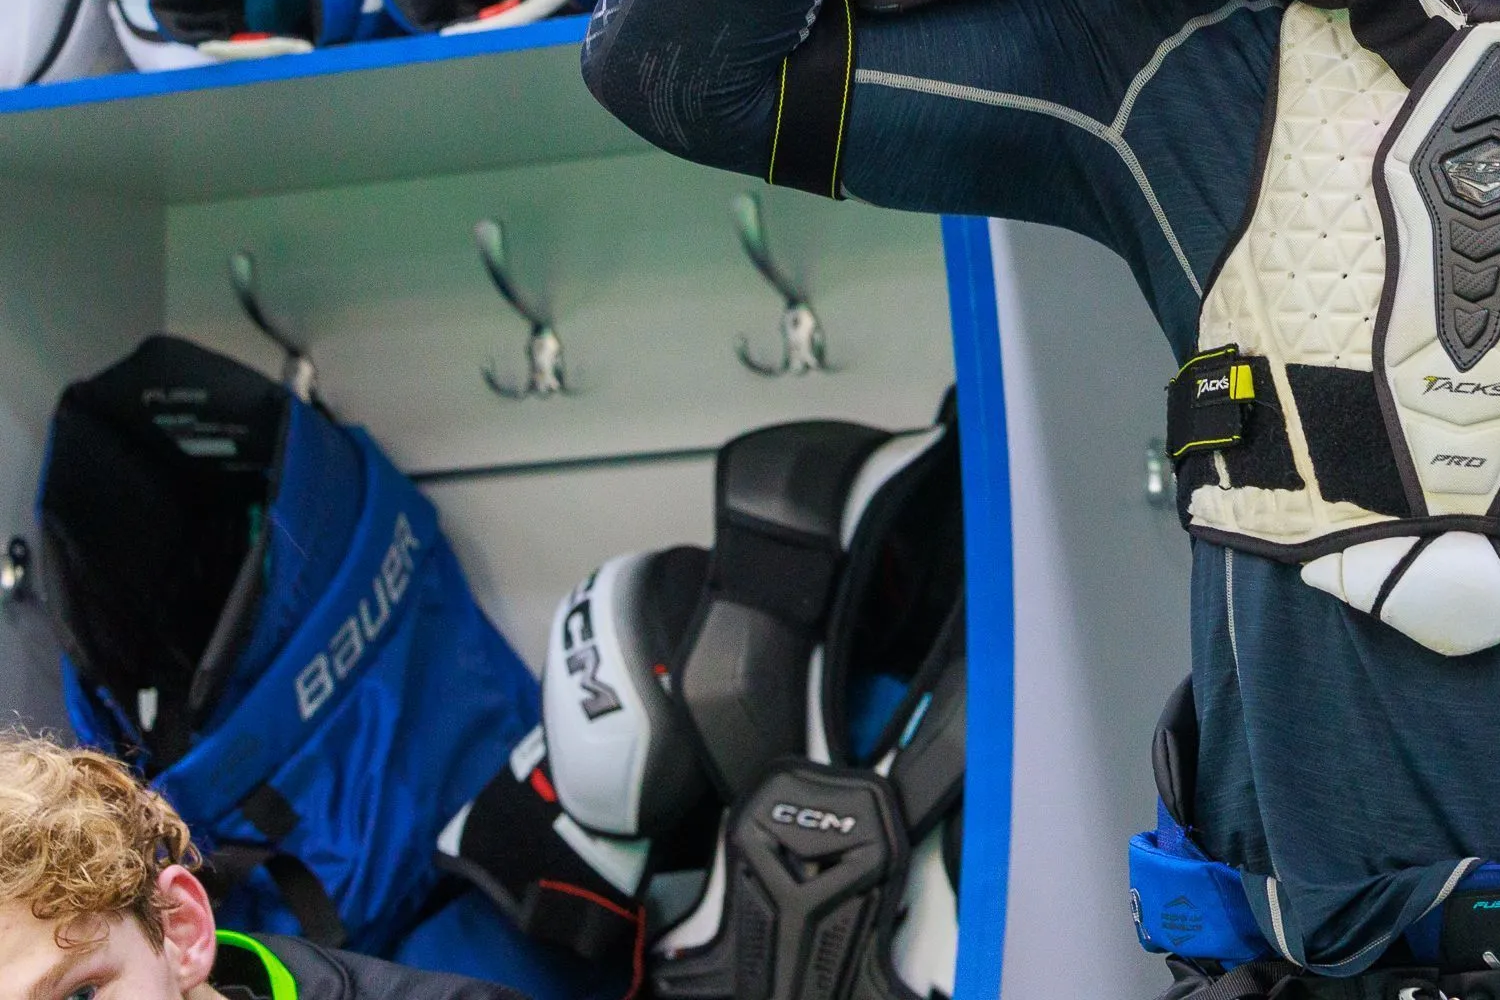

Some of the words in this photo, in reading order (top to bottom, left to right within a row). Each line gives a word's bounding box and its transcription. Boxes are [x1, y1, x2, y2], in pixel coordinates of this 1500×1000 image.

[1196, 375, 1230, 399] TACKS
[1430, 454, 1487, 468] PRO
[772, 803, 857, 833] CCM
